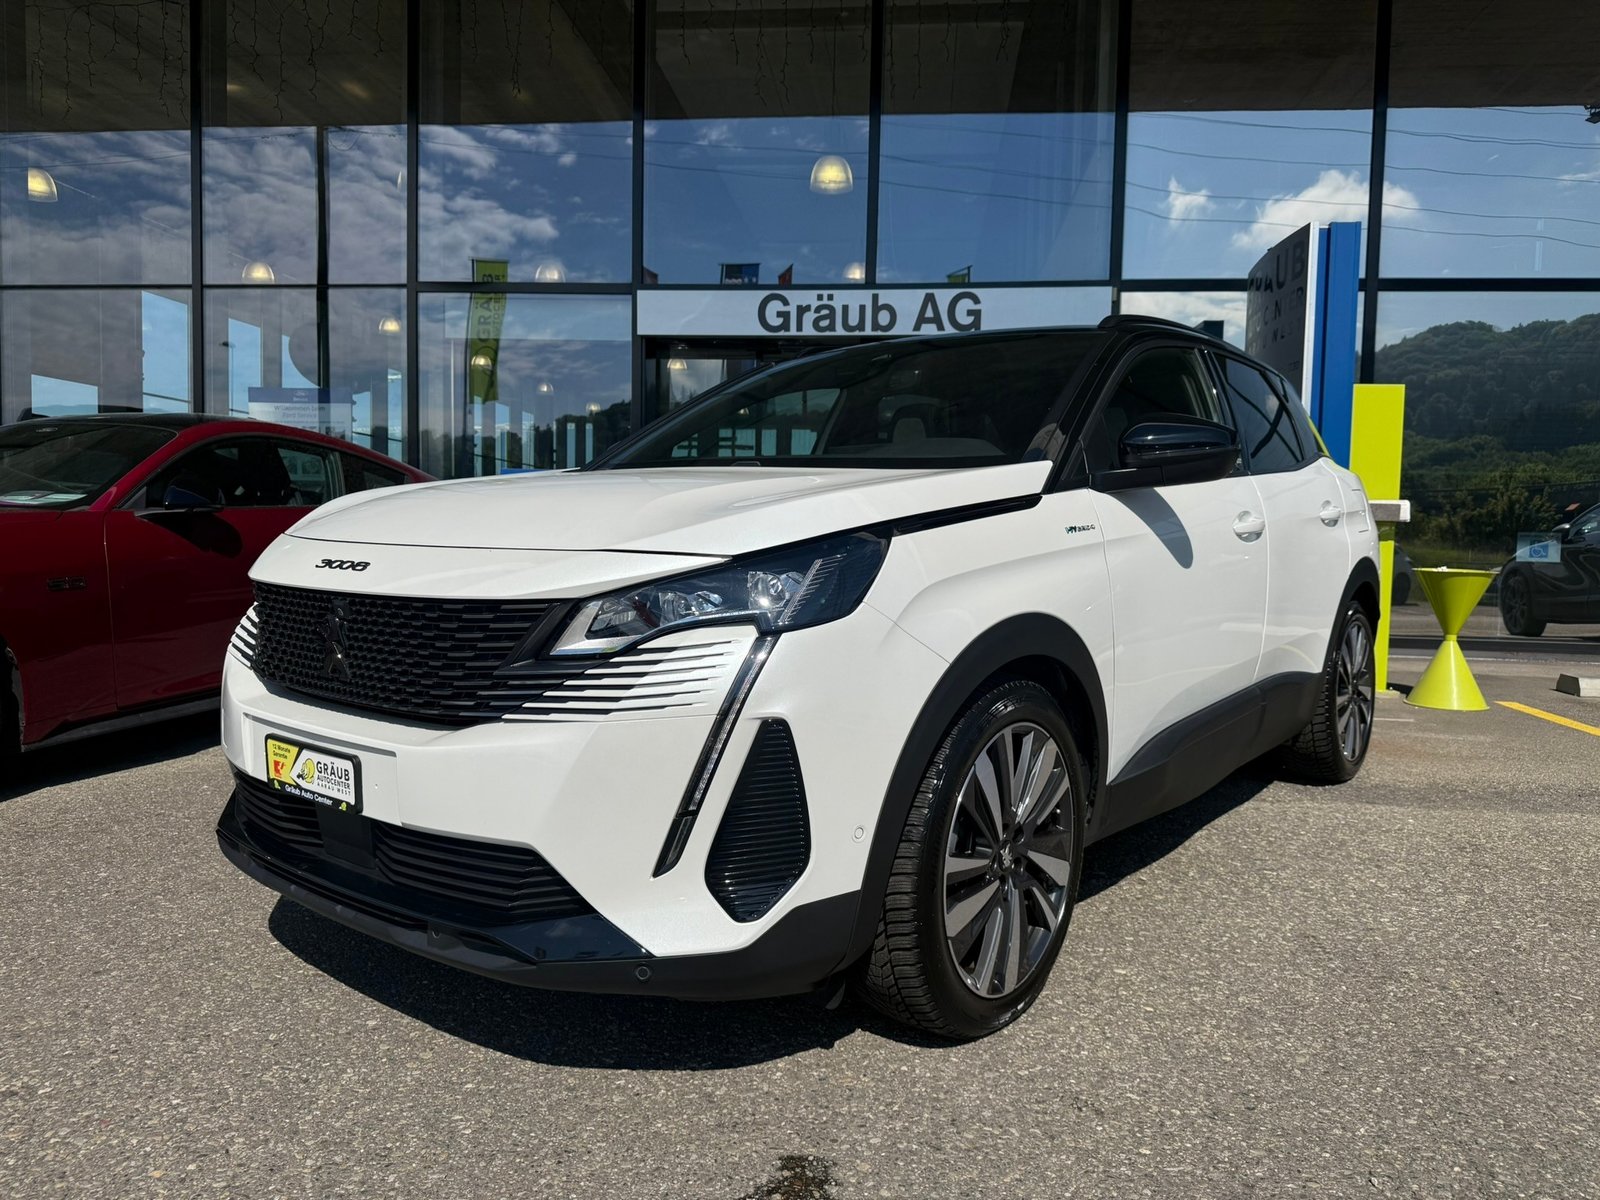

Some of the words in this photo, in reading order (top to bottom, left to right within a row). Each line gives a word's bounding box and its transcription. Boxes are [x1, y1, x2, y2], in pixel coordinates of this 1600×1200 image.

[475, 273, 494, 343] GRÄB
[757, 292, 897, 333] Gräub
[913, 291, 982, 333] AG
[315, 559, 371, 571] 3008
[316, 761, 350, 781] GRÄUB
[316, 774, 351, 790] AUTOCENTER
[284, 784, 301, 796] Gräub
[301, 790, 314, 800] Auto
[314, 793, 334, 806] Center
